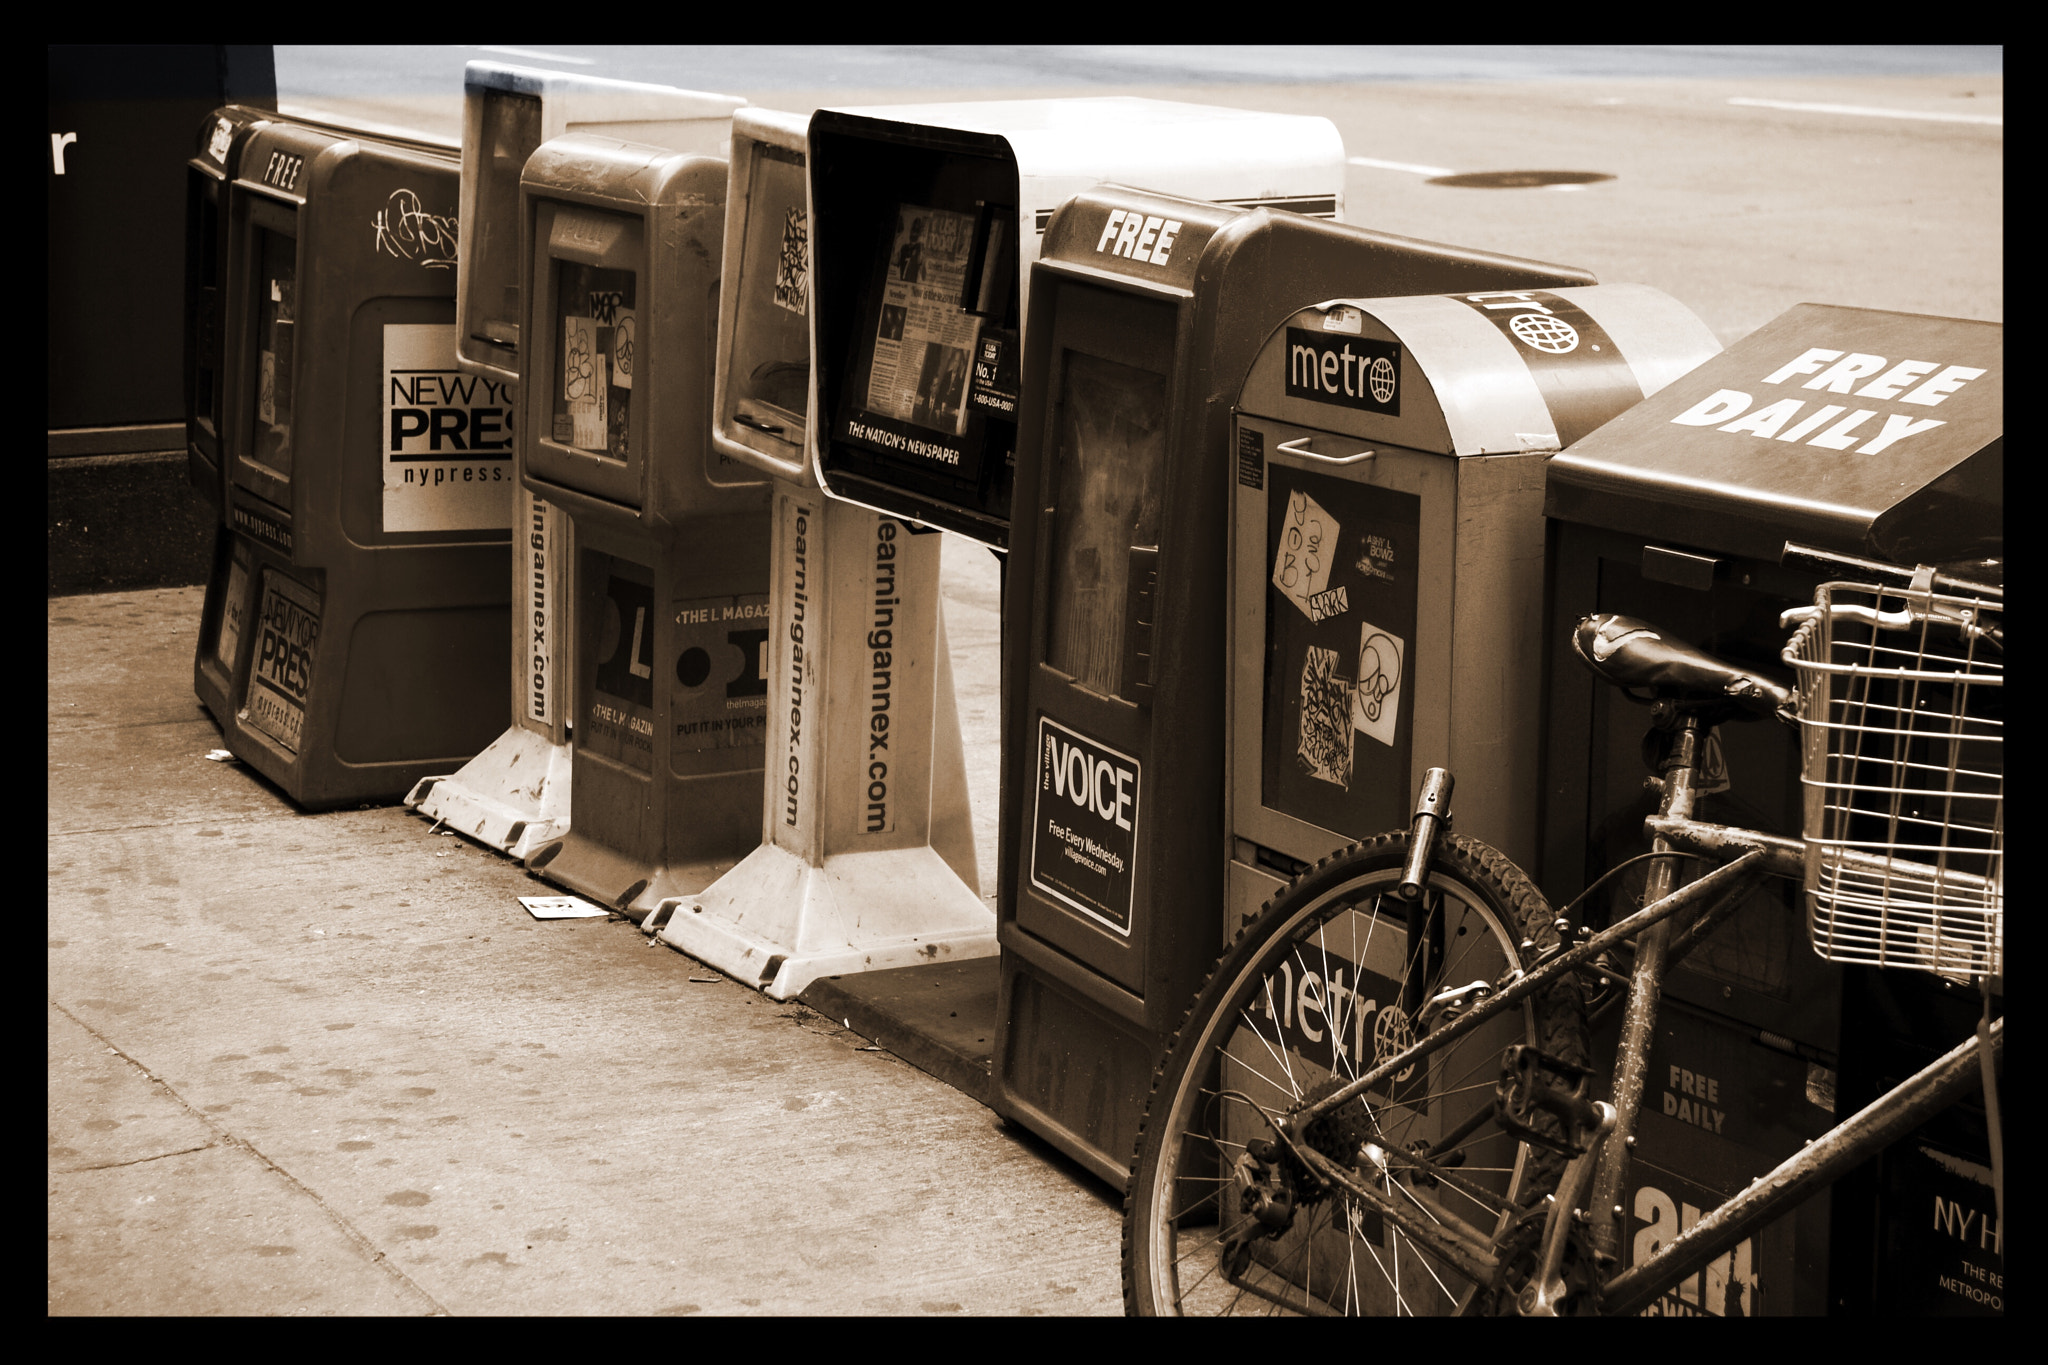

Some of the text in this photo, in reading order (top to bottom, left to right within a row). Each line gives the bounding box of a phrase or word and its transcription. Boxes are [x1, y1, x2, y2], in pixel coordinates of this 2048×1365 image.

[264, 151, 302, 190] FREE
[1096, 208, 1183, 267] FREE
[391, 376, 478, 406] NEW
[976, 362, 989, 379] No.
[1292, 343, 1395, 403] metro
[1760, 347, 1988, 407] FREE
[848, 421, 960, 466] THE NATION'S NEWSPAPER
[1669, 388, 1948, 456] DAILY
[265, 595, 297, 638] NEW
[680, 608, 708, 625] THE
[711, 607, 720, 622] L
[629, 606, 652, 680] L
[786, 506, 811, 827] learningannex.com
[677, 723, 699, 737] PUT
[700, 721, 710, 734] IT
[712, 719, 723, 732] IN
[724, 717, 754, 731] YOUR
[1050, 735, 1134, 833] VOICE
[1049, 819, 1125, 873] Free Every Wednesday.
[1064, 846, 1107, 877] villagevoice.com
[1669, 1064, 1719, 1104] FREE
[1663, 1090, 1726, 1135] DAILY
[1933, 1195, 1977, 1242] NY
[1961, 1260, 1986, 1282] THE
